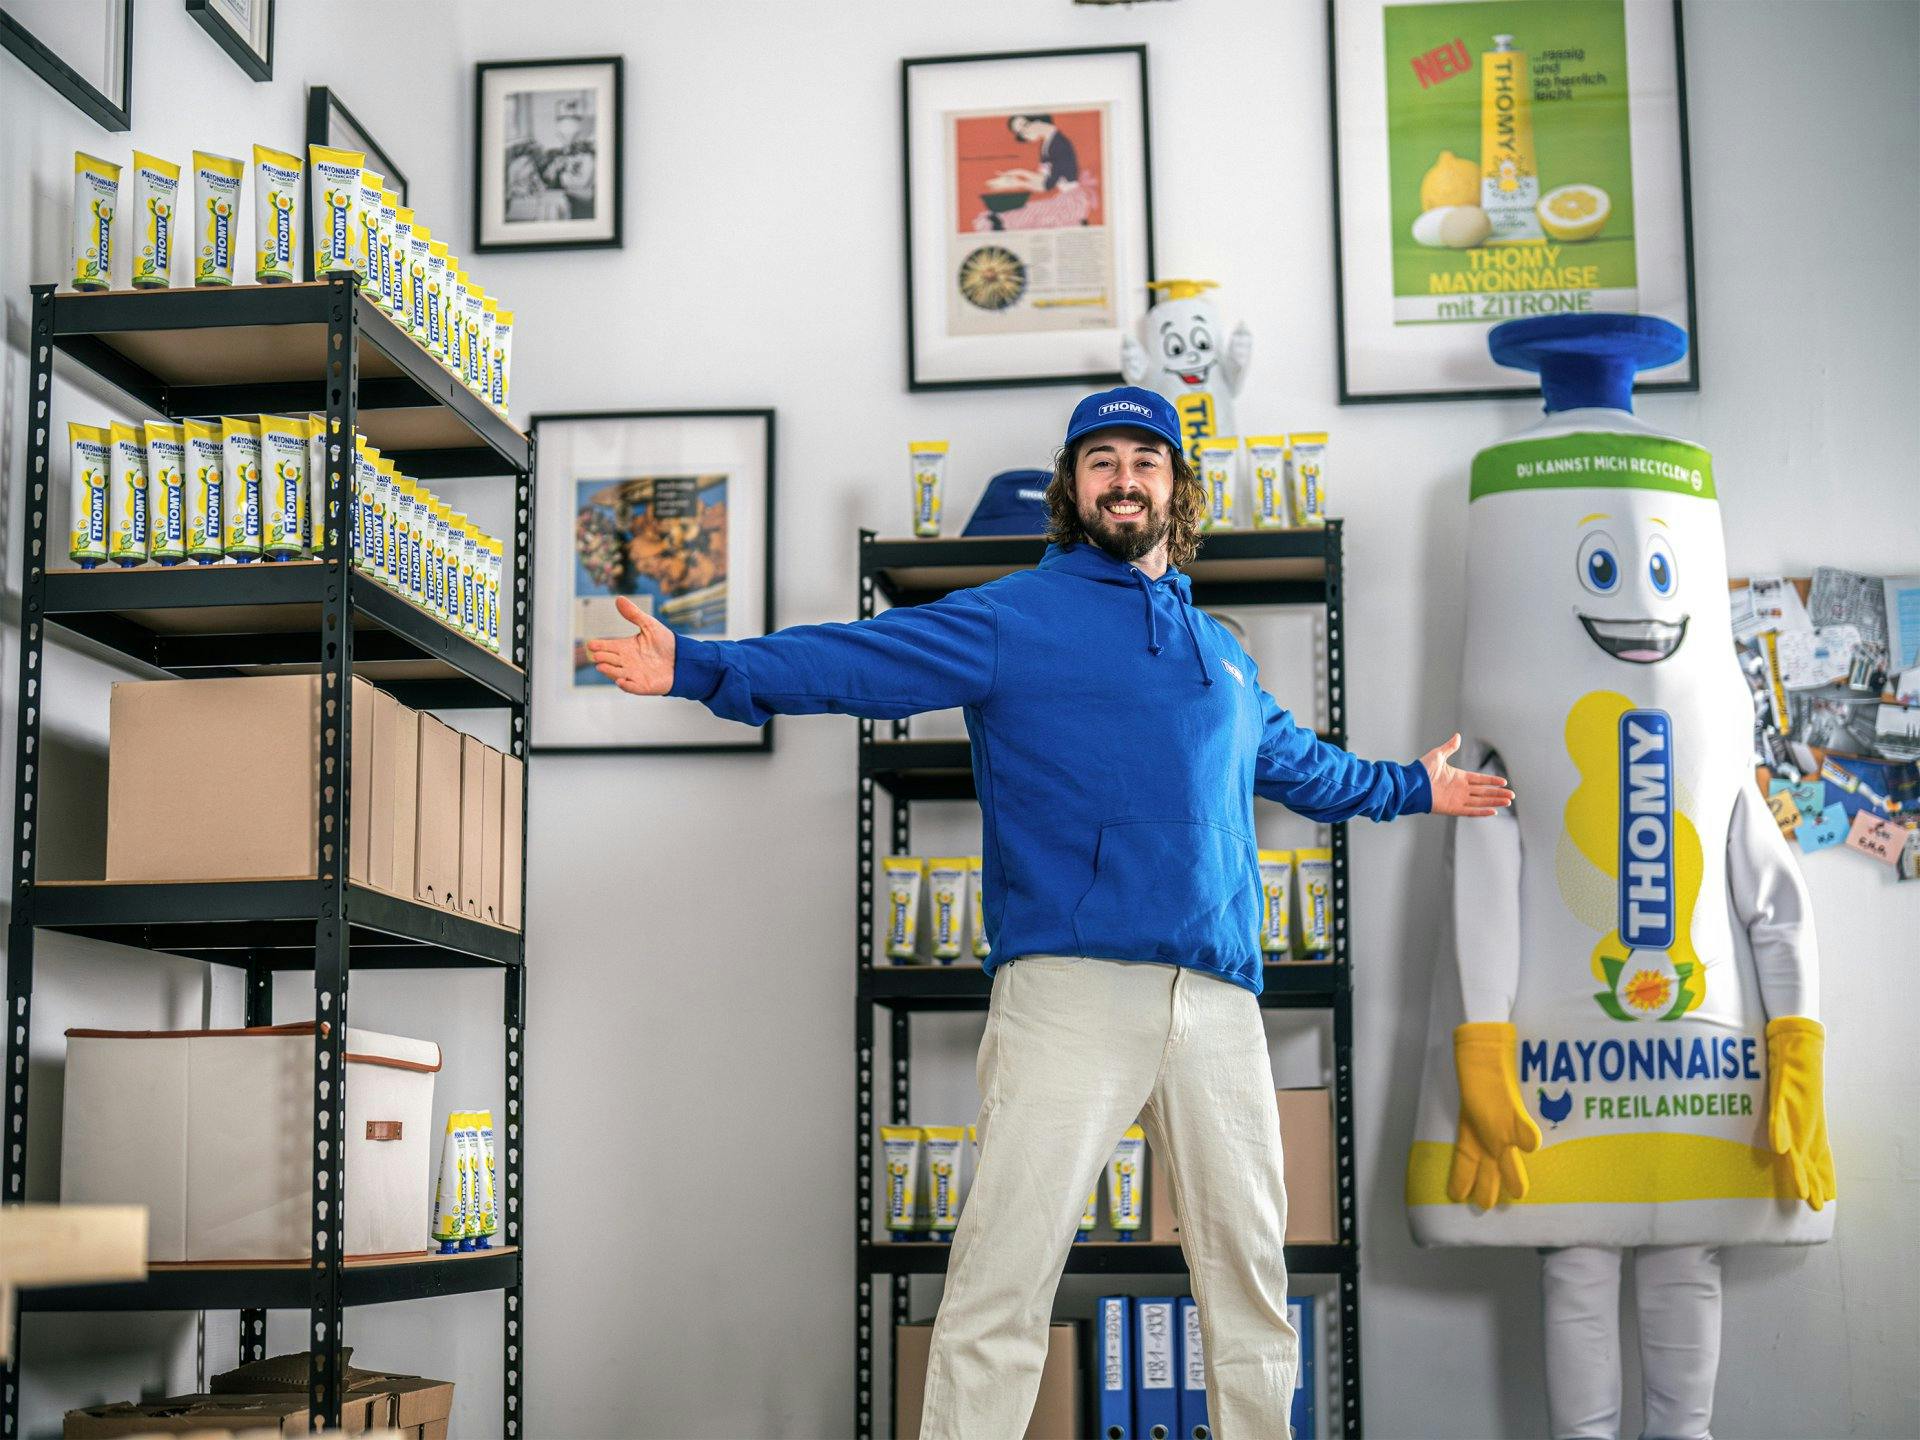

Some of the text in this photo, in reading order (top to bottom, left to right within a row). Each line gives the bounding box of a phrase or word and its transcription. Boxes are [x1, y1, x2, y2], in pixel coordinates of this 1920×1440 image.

[1411, 37, 1472, 89] NEU
[1533, 61, 1560, 74] und
[1494, 60, 1515, 152] THOMY
[142, 170, 178, 187] MAYONNAISE
[200, 170, 240, 186] MAYONNAISE
[262, 164, 300, 179] MAYONNAISE
[318, 164, 360, 176] MAYONNAISE
[158, 218, 166, 267] THOMY
[217, 216, 227, 266] THOMY
[279, 210, 289, 260] THOMY
[335, 209, 345, 258] THOMY
[369, 230, 378, 278] THOMY
[382, 247, 390, 296] THOMY
[1430, 266, 1598, 293] MAYONNAISE
[1466, 247, 1561, 270] THOMY
[415, 278, 423, 326] THOMY
[430, 295, 438, 341] THOMY
[1438, 293, 1592, 317] mit ZITRONE
[470, 334, 478, 380] THOMY
[1101, 402, 1150, 416] THOMY
[268, 434, 309, 447] MAYONNAISE
[1517, 463, 1533, 477] DU
[1536, 457, 1590, 475] KANNST
[1593, 456, 1628, 470] MICH
[92, 488, 102, 538] THOMY
[135, 490, 146, 542] THOMY
[169, 488, 180, 538] THOMY
[208, 486, 219, 535] THOMY
[247, 484, 258, 534] THOMY
[286, 482, 296, 532] THOMY
[365, 506, 374, 556] THOMY
[375, 516, 384, 566] THOMY
[400, 534, 408, 584] THOMY
[412, 542, 420, 591] THOMY
[426, 551, 434, 599] THOMY
[449, 567, 458, 614] THOMY
[464, 577, 472, 623] THOMY
[1628, 721, 1666, 938] THOMY
[1521, 1037, 1760, 1083] MAYONNAISE
[1584, 1094, 1753, 1119] FREILANDEIER
